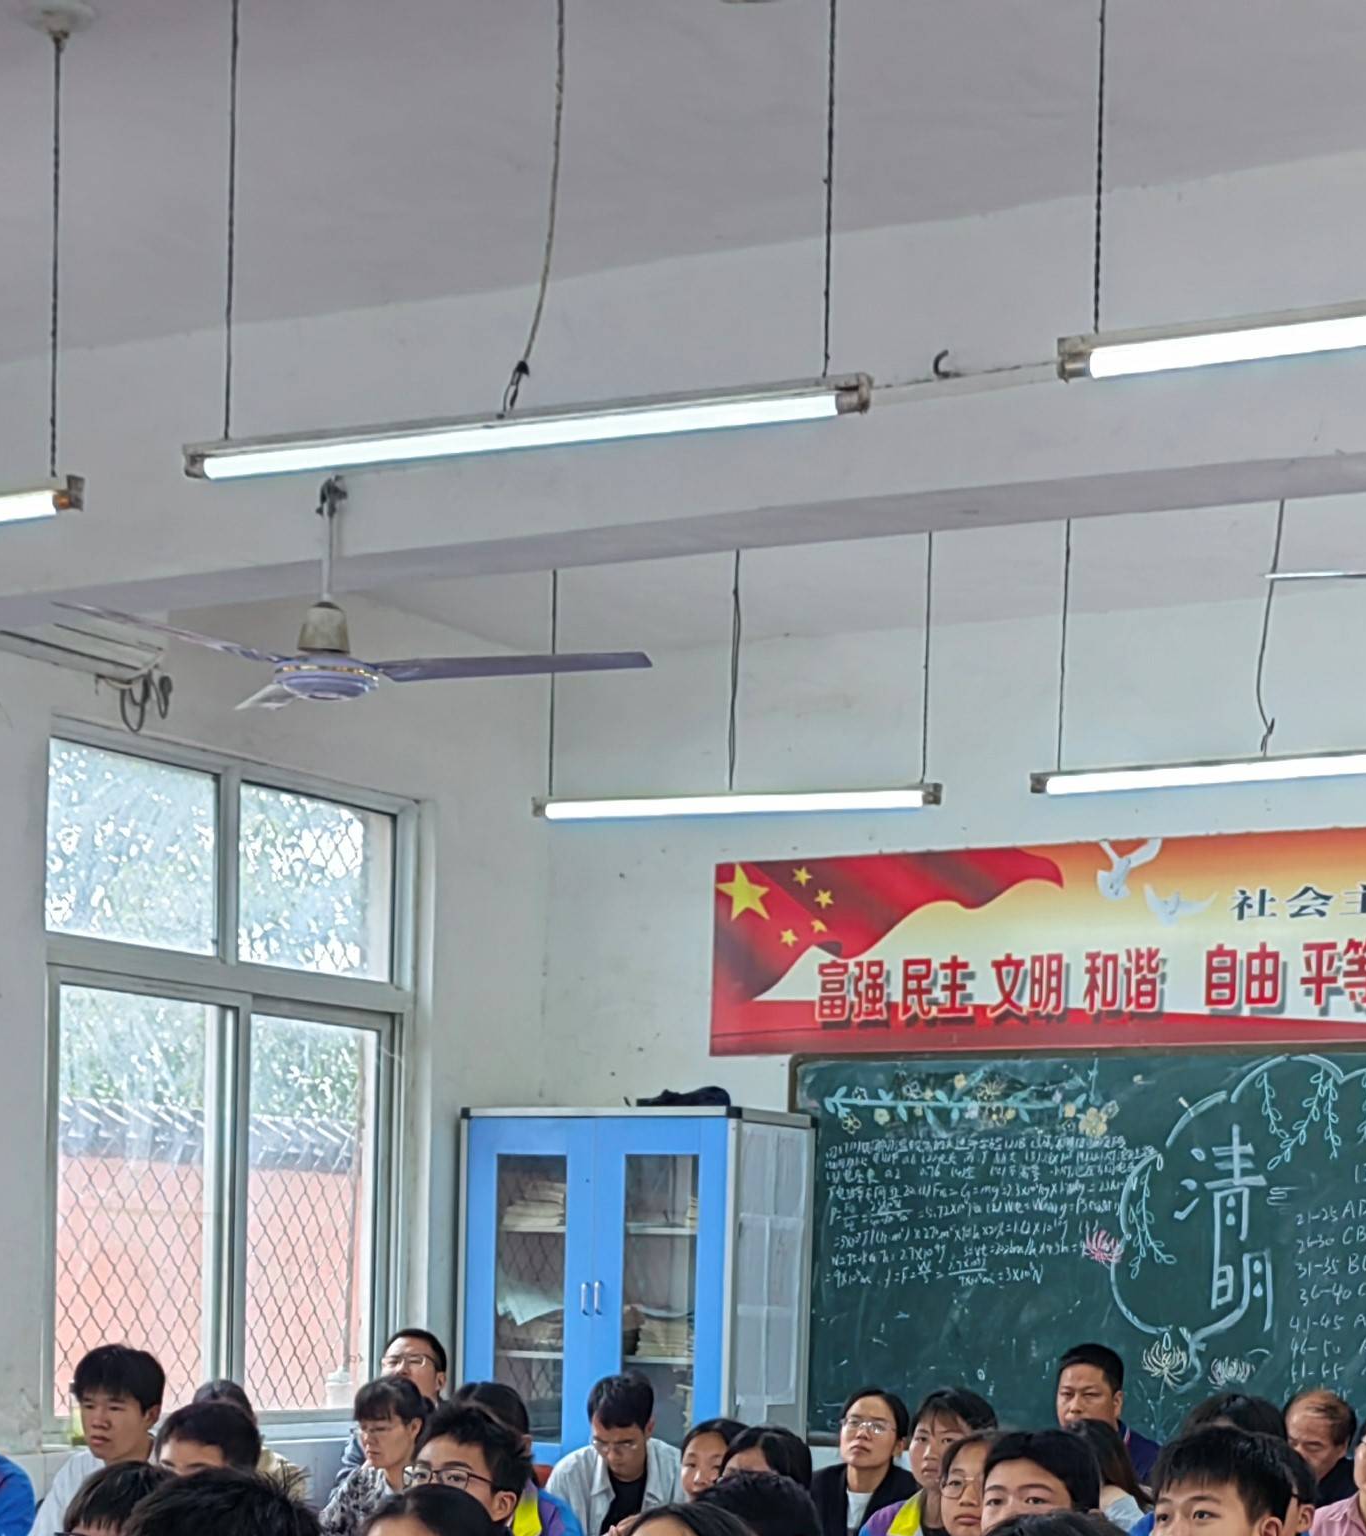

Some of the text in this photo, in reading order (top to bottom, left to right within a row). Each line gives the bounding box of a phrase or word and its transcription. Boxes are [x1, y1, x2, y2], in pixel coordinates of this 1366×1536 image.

[816, 959, 887, 1022] 富强
[900, 953, 970, 1017] 民主
[990, 951, 1064, 1015] 文明
[1084, 945, 1162, 1013] 和谐
[1206, 940, 1281, 1006] 自由
[1173, 1124, 1275, 1332] 清明
